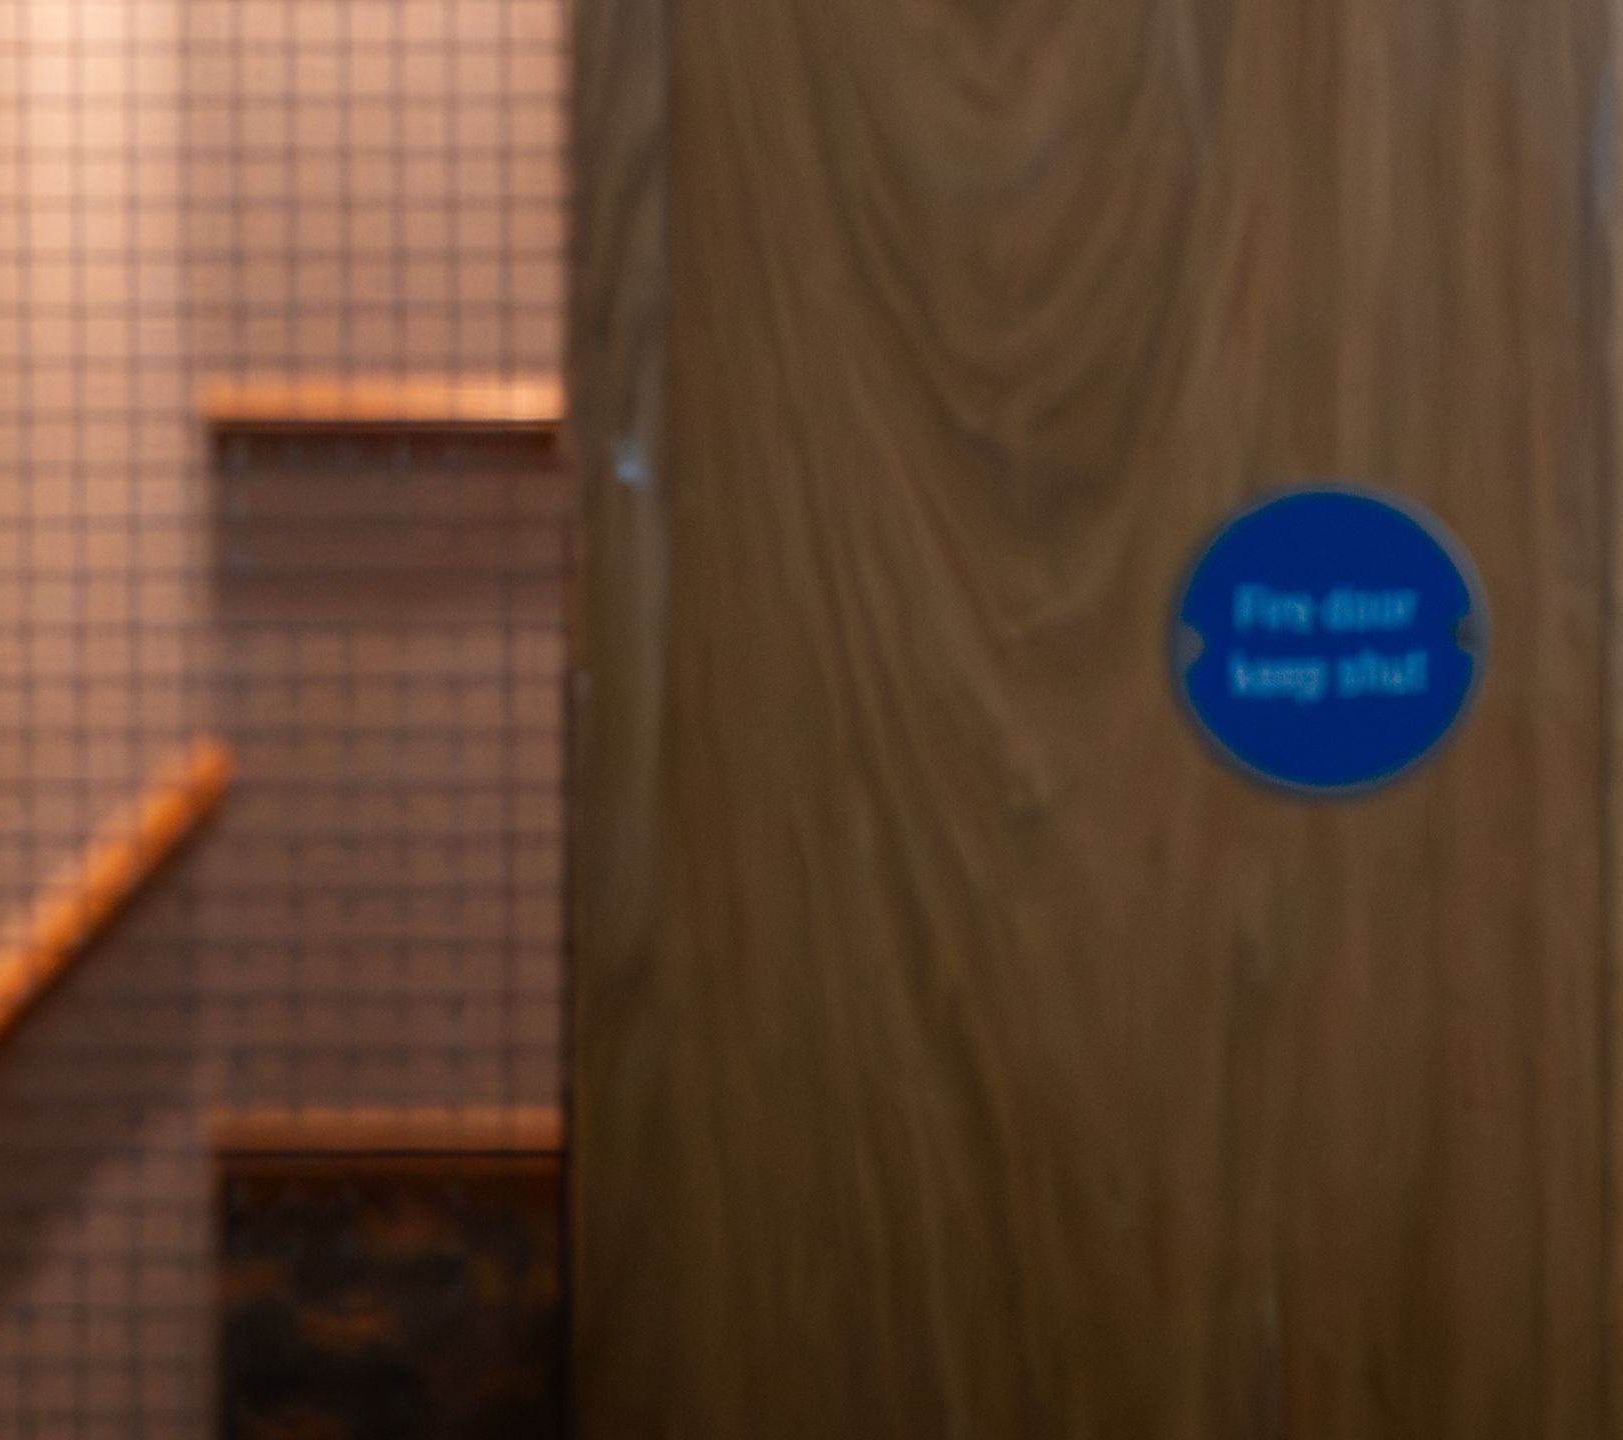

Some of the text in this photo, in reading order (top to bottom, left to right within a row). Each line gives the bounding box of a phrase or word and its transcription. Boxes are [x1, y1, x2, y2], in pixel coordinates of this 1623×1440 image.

[1234, 584, 1418, 633] Fire door
[1230, 649, 1428, 705] keep shut
